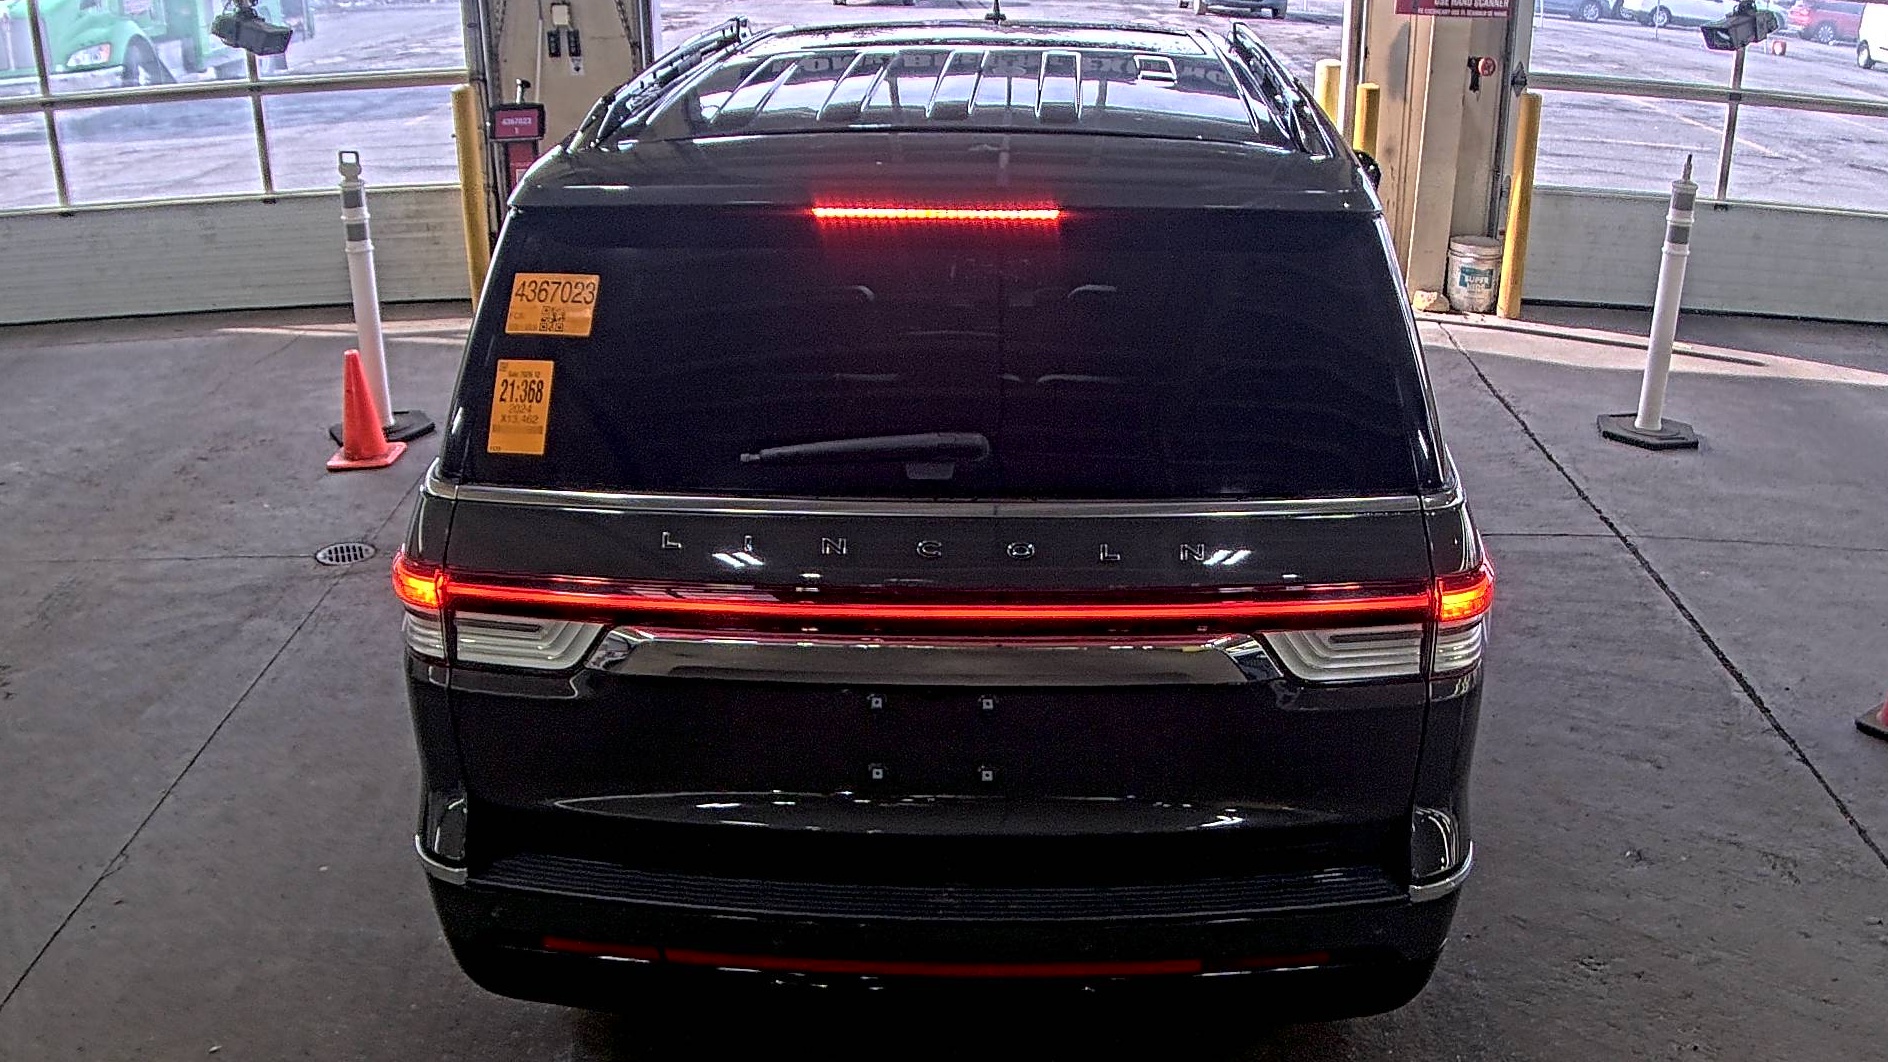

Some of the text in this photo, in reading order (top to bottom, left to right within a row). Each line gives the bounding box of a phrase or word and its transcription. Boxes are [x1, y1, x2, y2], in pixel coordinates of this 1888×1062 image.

[514, 279, 597, 305] 4367023
[499, 378, 544, 403] 21:368
[661, 531, 1206, 562] LINCOLN
